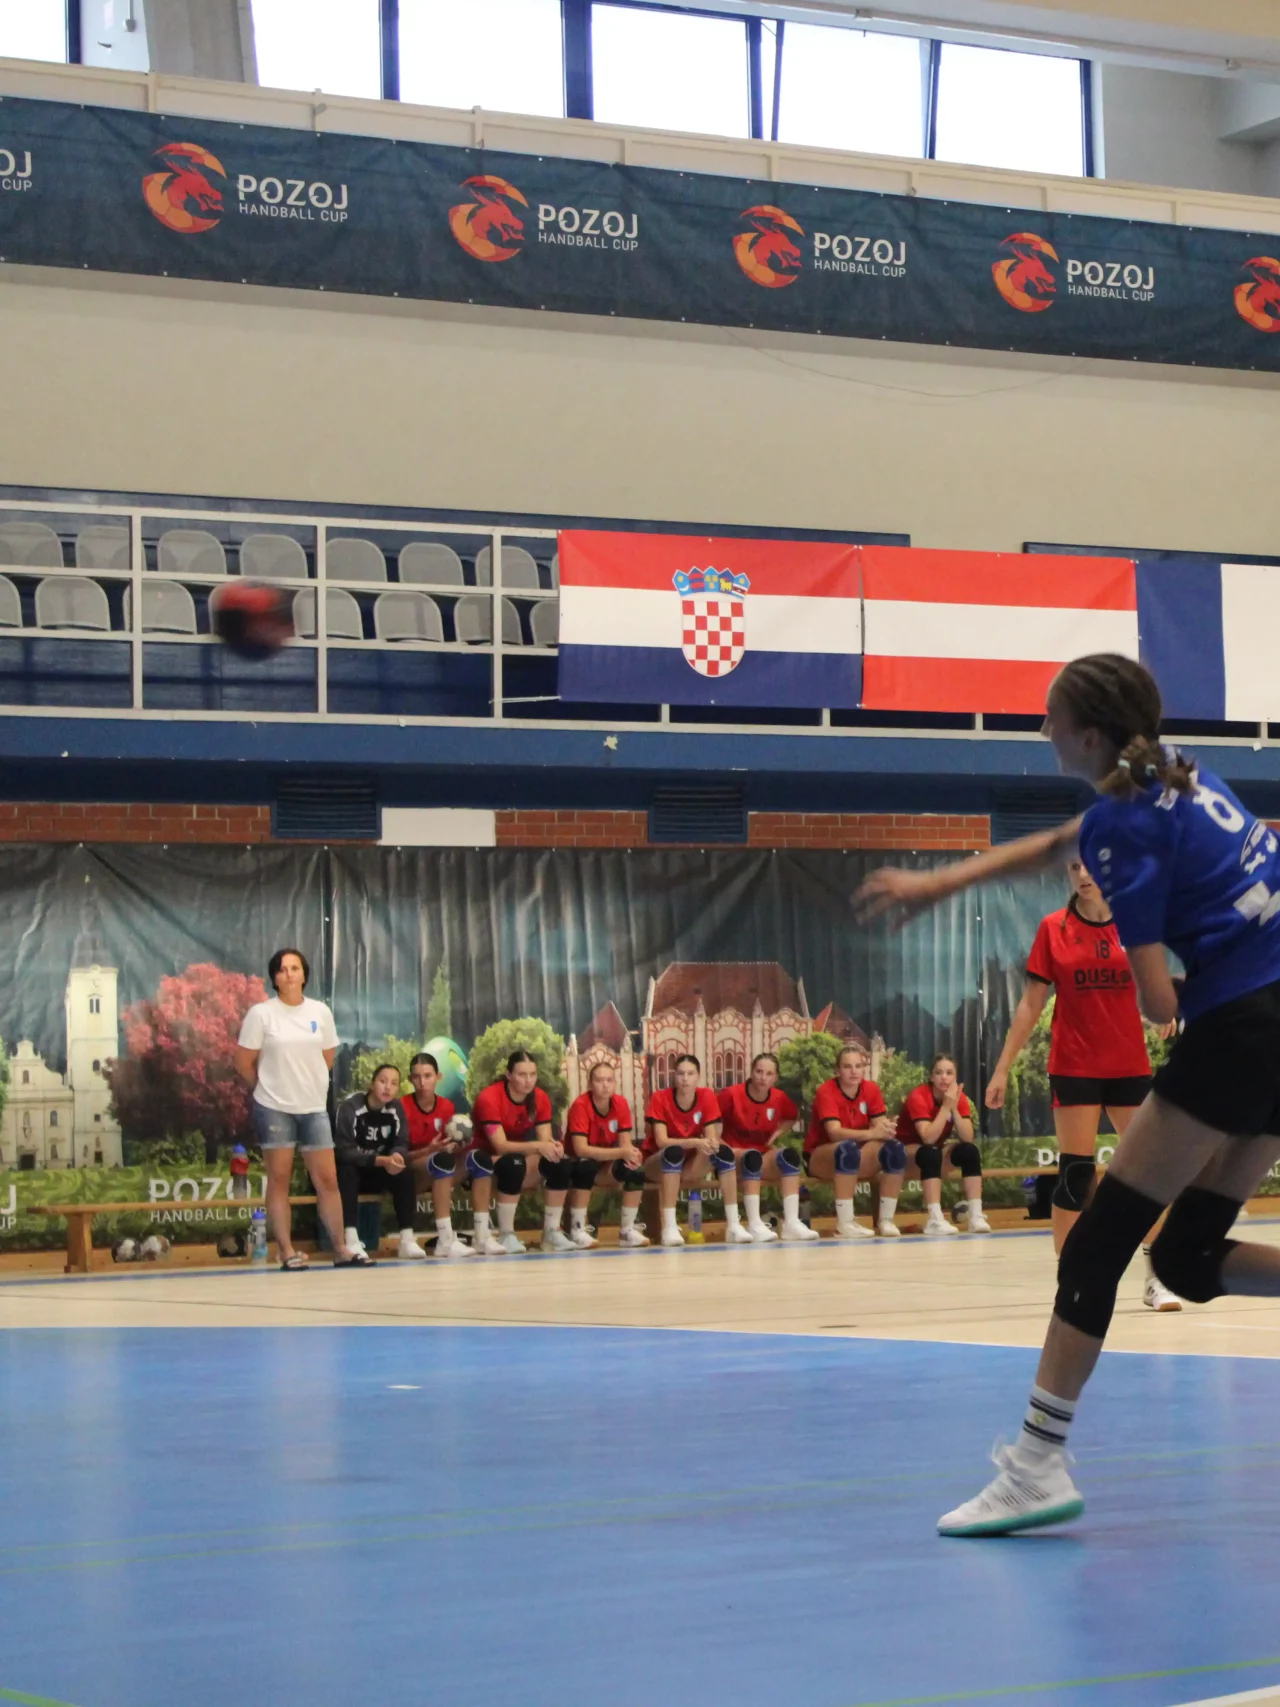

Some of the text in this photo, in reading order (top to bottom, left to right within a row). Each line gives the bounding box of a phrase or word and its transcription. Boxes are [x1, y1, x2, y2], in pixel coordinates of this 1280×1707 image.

[3, 178, 33, 191] CUP
[237, 174, 348, 210] POZOJ
[239, 203, 348, 223] HANDBALL CUP
[537, 204, 638, 239] POZOJ
[538, 233, 638, 251] HANDBALL CUP
[813, 232, 906, 266] POZOJ
[814, 259, 906, 278] HANDBALL CUP
[1066, 259, 1154, 290] POZOJ
[1068, 285, 1155, 302] HANDBALL CUP
[1094, 939, 1110, 959] 18
[908, 1179, 924, 1193] CU
[150, 1207, 232, 1223] HANDBALL
